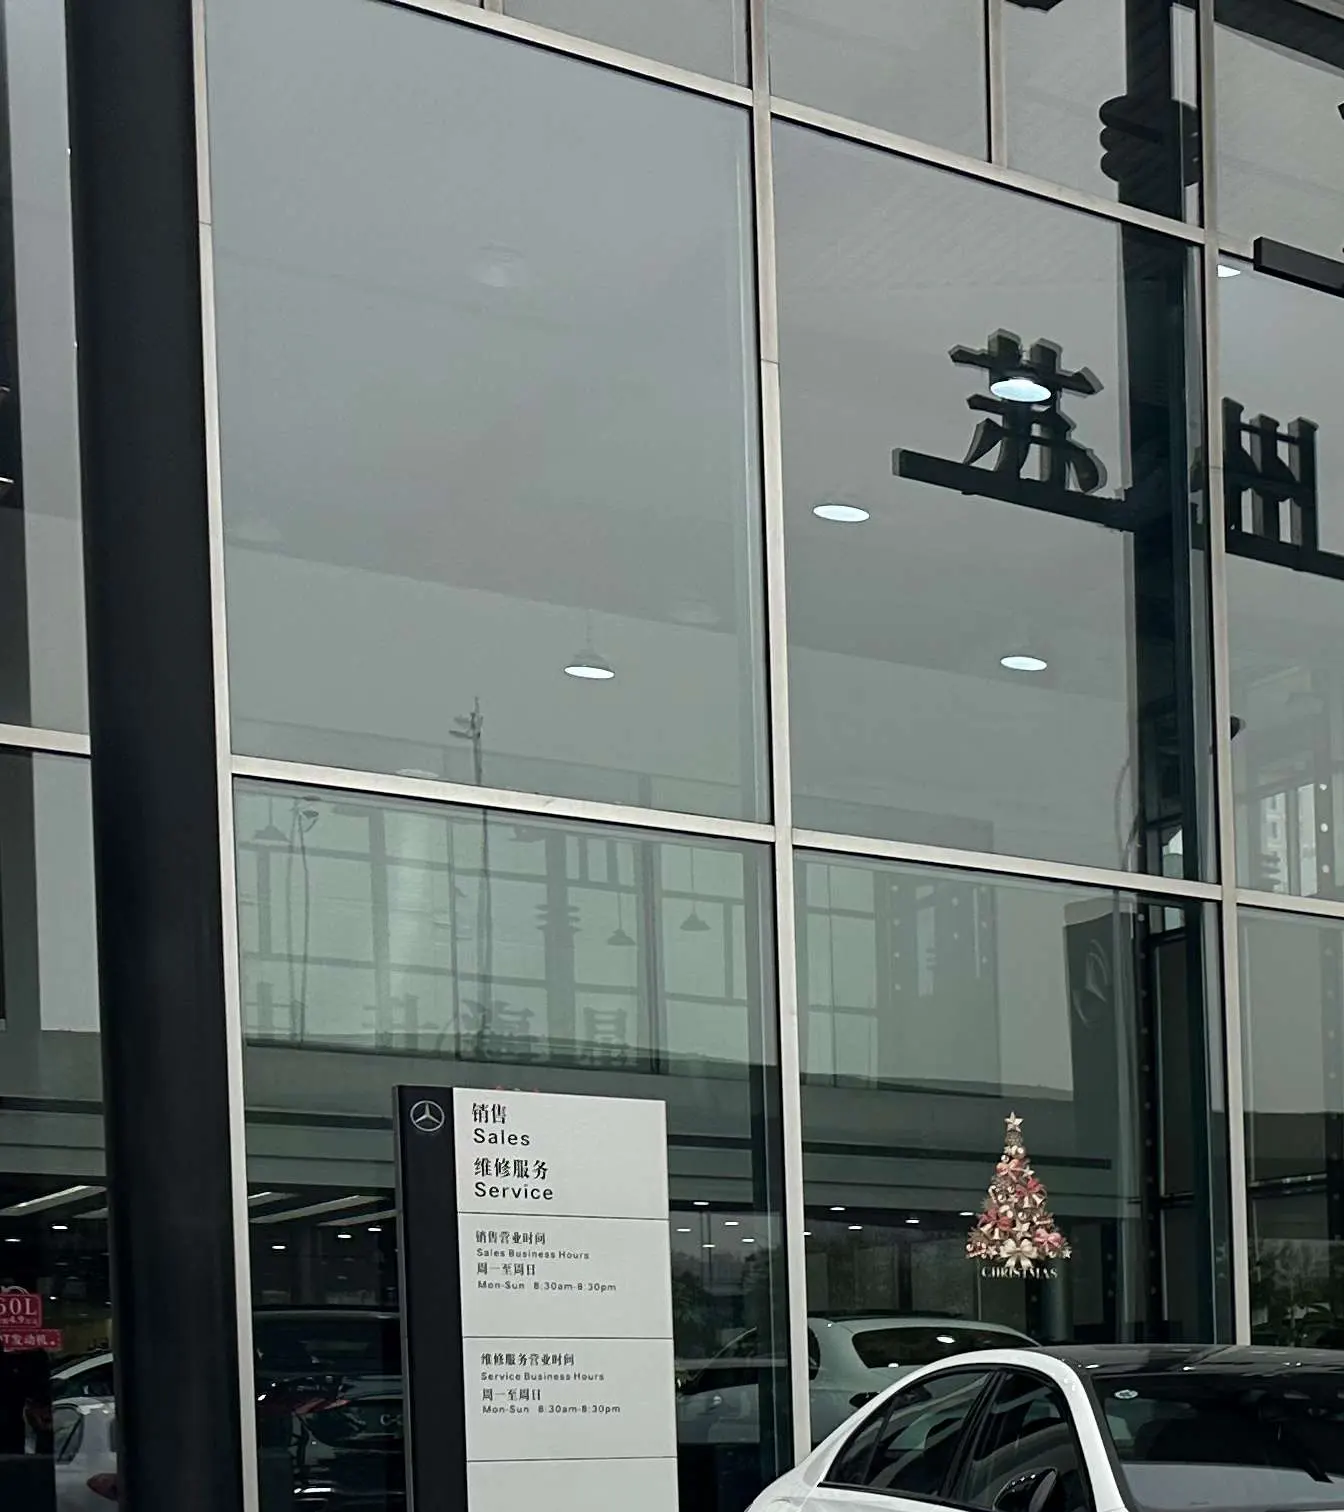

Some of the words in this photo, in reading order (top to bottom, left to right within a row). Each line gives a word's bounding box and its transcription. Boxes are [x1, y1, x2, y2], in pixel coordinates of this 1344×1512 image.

[471, 1102, 507, 1125] 销售
[473, 1127, 531, 1146] Sales
[473, 1157, 549, 1180] 维修服务
[474, 1181, 554, 1201] Service
[475, 1229, 546, 1246] 销售营业时间
[476, 1247, 506, 1258] Sales
[508, 1248, 556, 1260] Business
[558, 1250, 590, 1260] Hours
[476, 1261, 536, 1276] 周一至周日
[980, 1266, 1058, 1279] CHRISTMAS
[477, 1280, 525, 1291] Mon-Sun
[480, 1352, 575, 1367] 维修服务营业时间
[480, 1371, 522, 1382] Service
[524, 1371, 571, 1382] Business
[573, 1371, 605, 1382] Hours
[482, 1387, 542, 1402] 周一至周日
[482, 1405, 530, 1415] Mon-Sun
